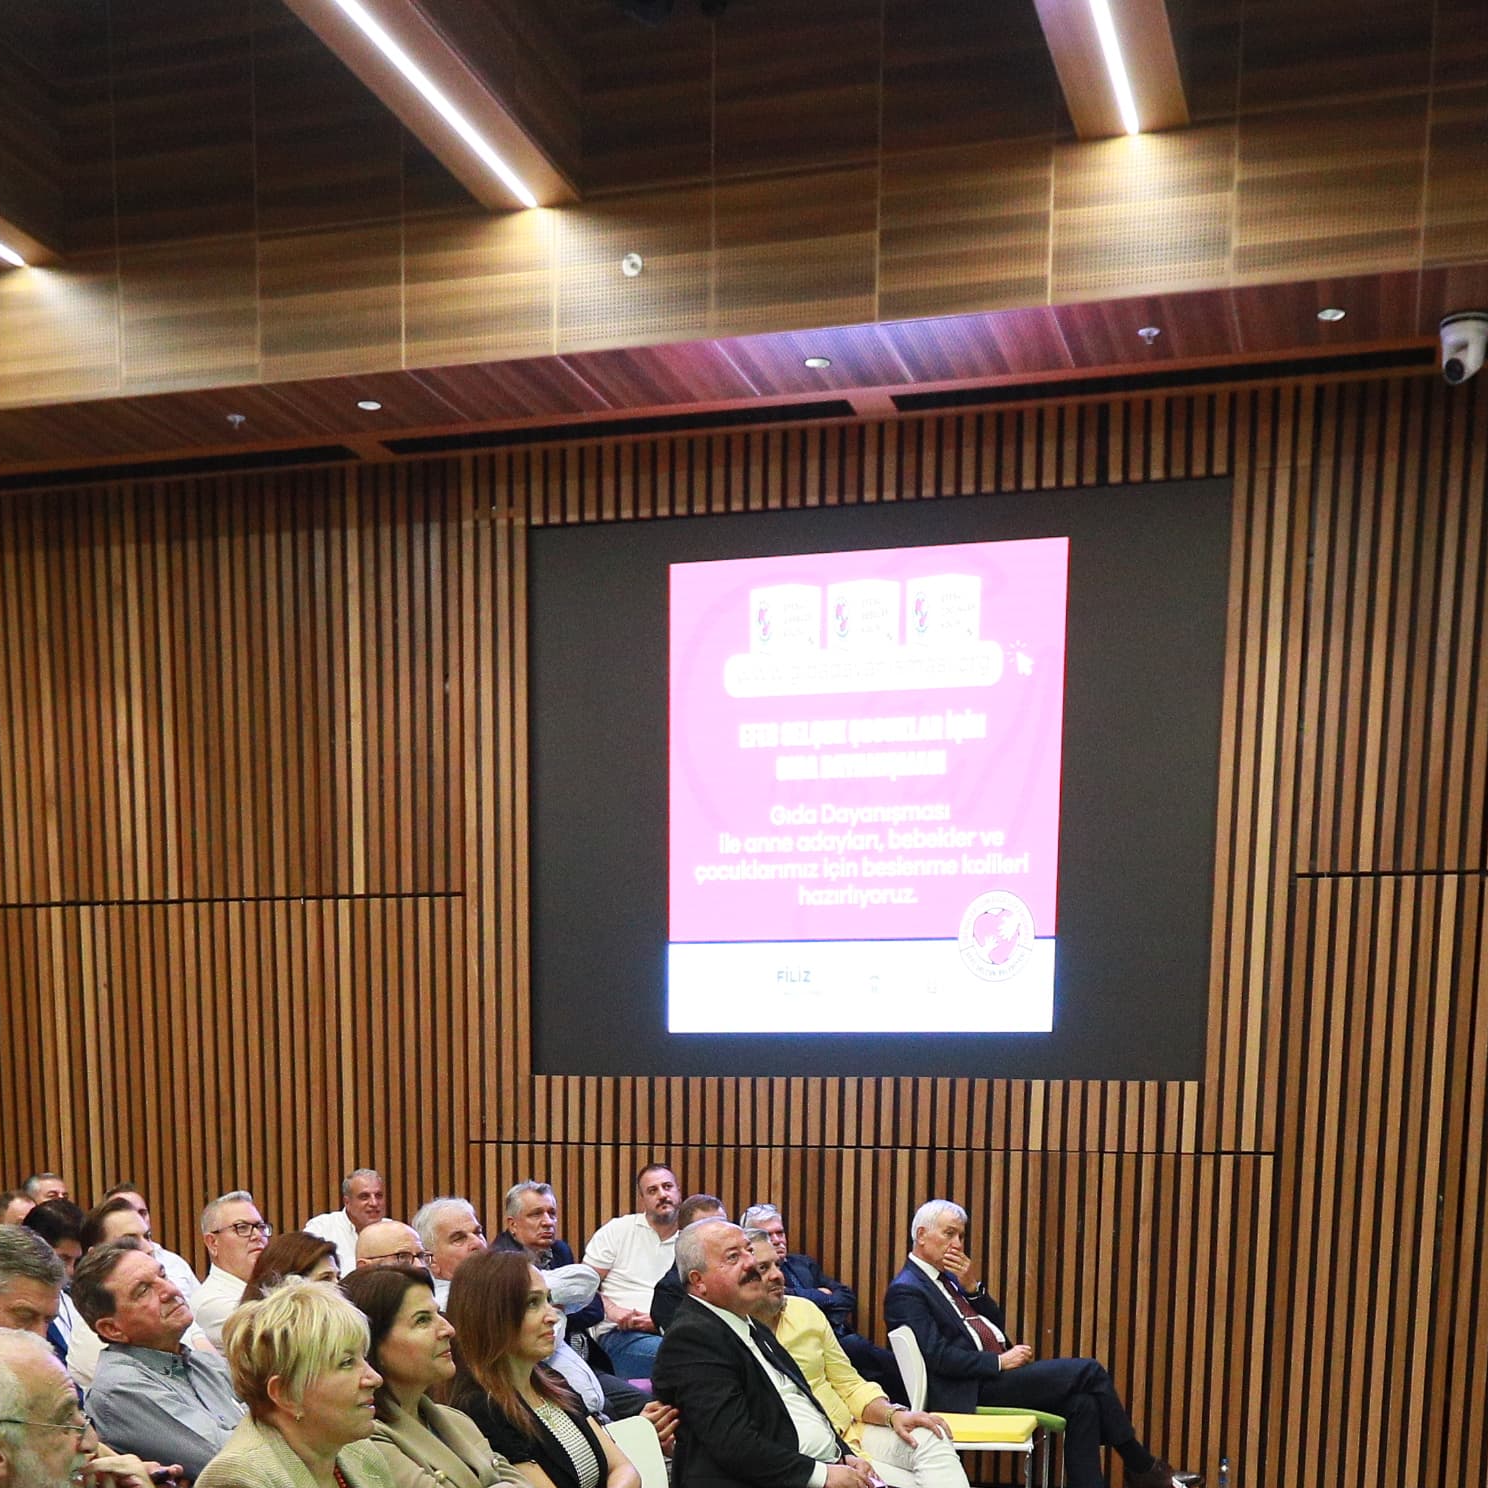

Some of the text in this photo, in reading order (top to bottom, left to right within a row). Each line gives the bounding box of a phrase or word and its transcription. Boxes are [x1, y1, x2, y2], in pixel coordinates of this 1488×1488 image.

[744, 835, 794, 854] anne
[887, 829, 975, 850] bebekler
[980, 831, 1005, 848] ve
[823, 855, 858, 880] için
[862, 854, 957, 877] beslenme
[776, 966, 812, 984] FİLİZ
